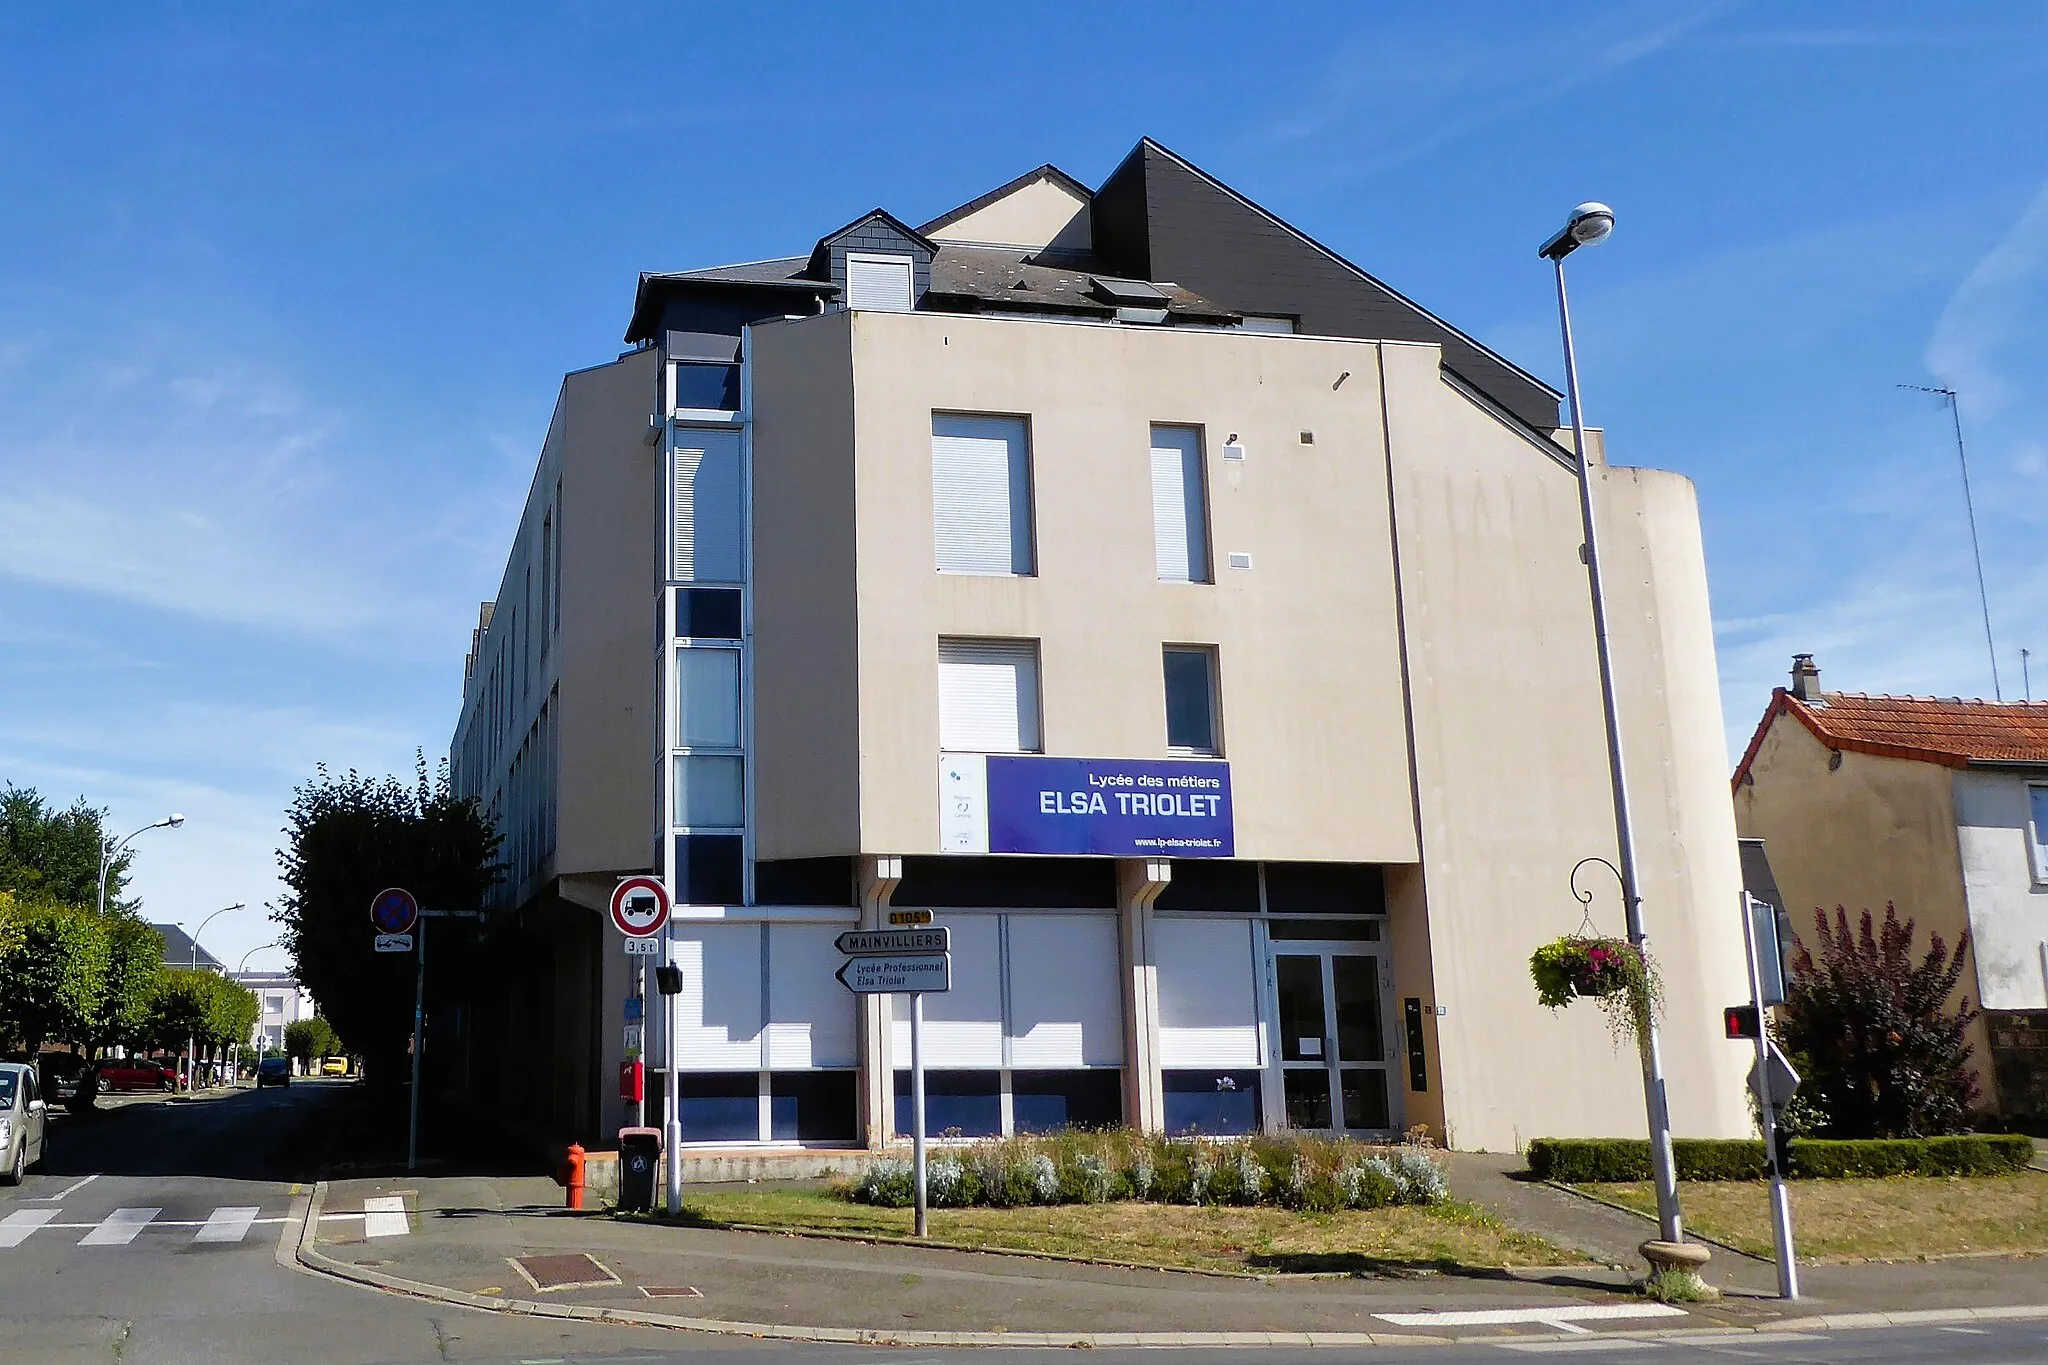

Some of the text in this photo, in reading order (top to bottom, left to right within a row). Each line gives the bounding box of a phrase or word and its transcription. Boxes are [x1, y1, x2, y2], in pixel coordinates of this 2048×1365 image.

[1089, 773, 1220, 788] Lycée des métiers
[1040, 791, 1221, 817] ELSA TRIOLET
[1134, 837, 1222, 848] www.lp-elsa-triolet.fr
[628, 941, 646, 953] 3,5
[849, 934, 942, 949] MAINVILLIERS
[856, 962, 943, 974] Lycée Professionnel
[857, 975, 906, 986] Elsa Triolet
